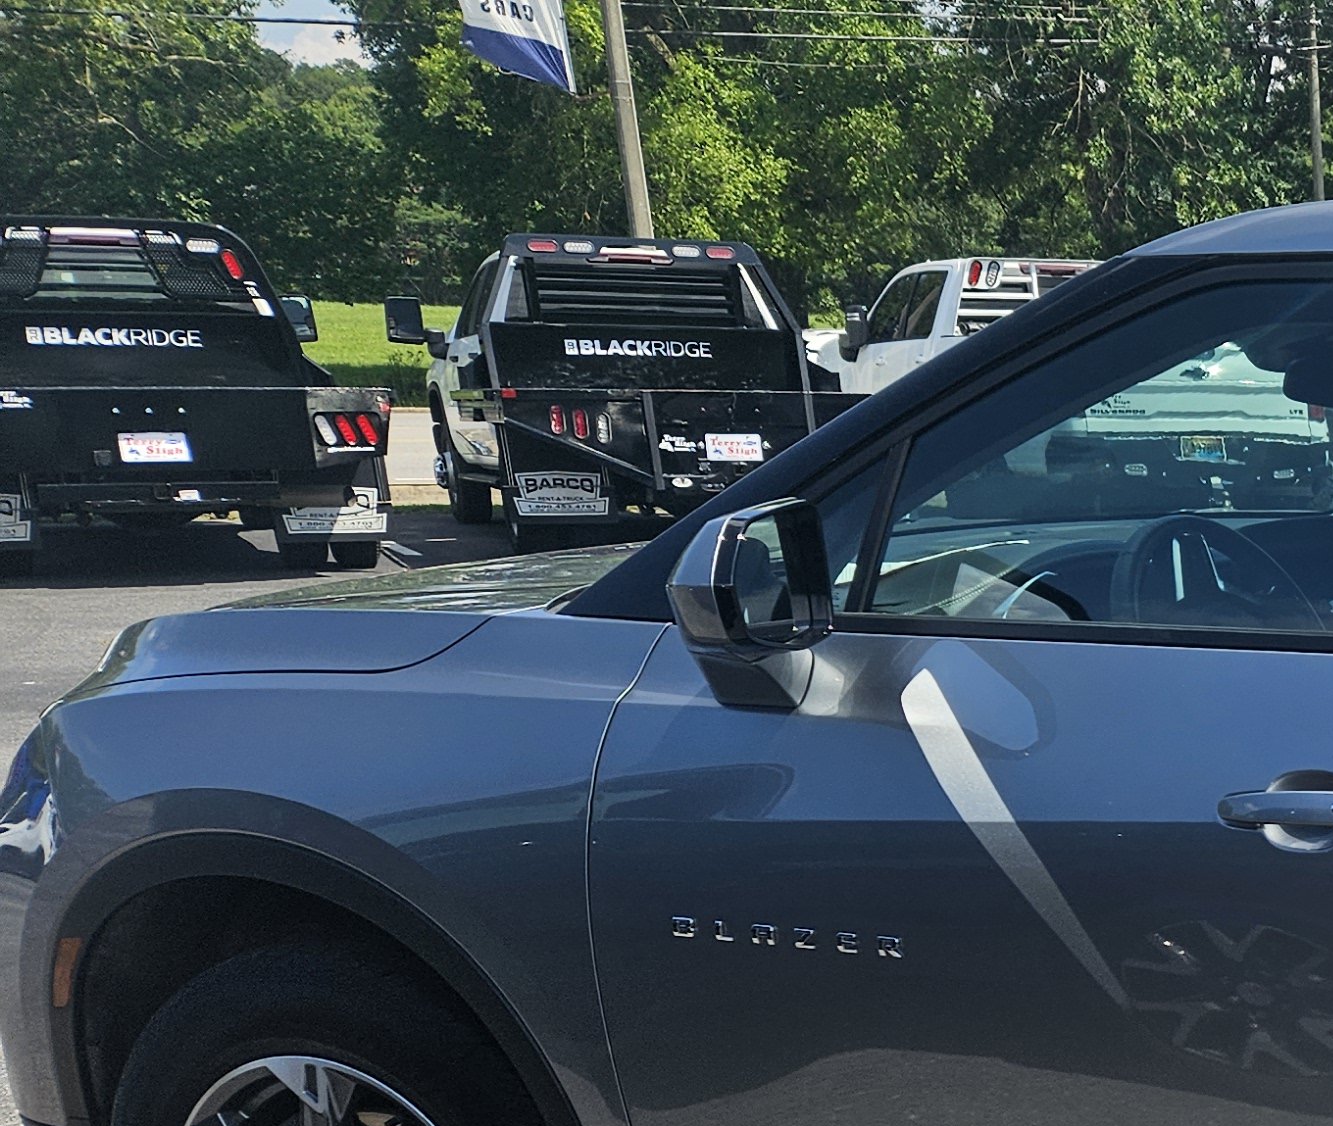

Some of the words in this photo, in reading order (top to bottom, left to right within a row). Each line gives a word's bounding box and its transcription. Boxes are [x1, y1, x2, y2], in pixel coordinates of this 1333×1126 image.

[43, 327, 204, 347] BLACKRIDGE
[579, 339, 713, 358] BLACKRIDGE
[124, 437, 161, 446] Terry
[710, 438, 741, 446] Terry
[146, 446, 183, 455] Sligh
[728, 447, 757, 455] Sligh
[524, 478, 594, 493] BARCO
[671, 915, 905, 959] BLAZER
